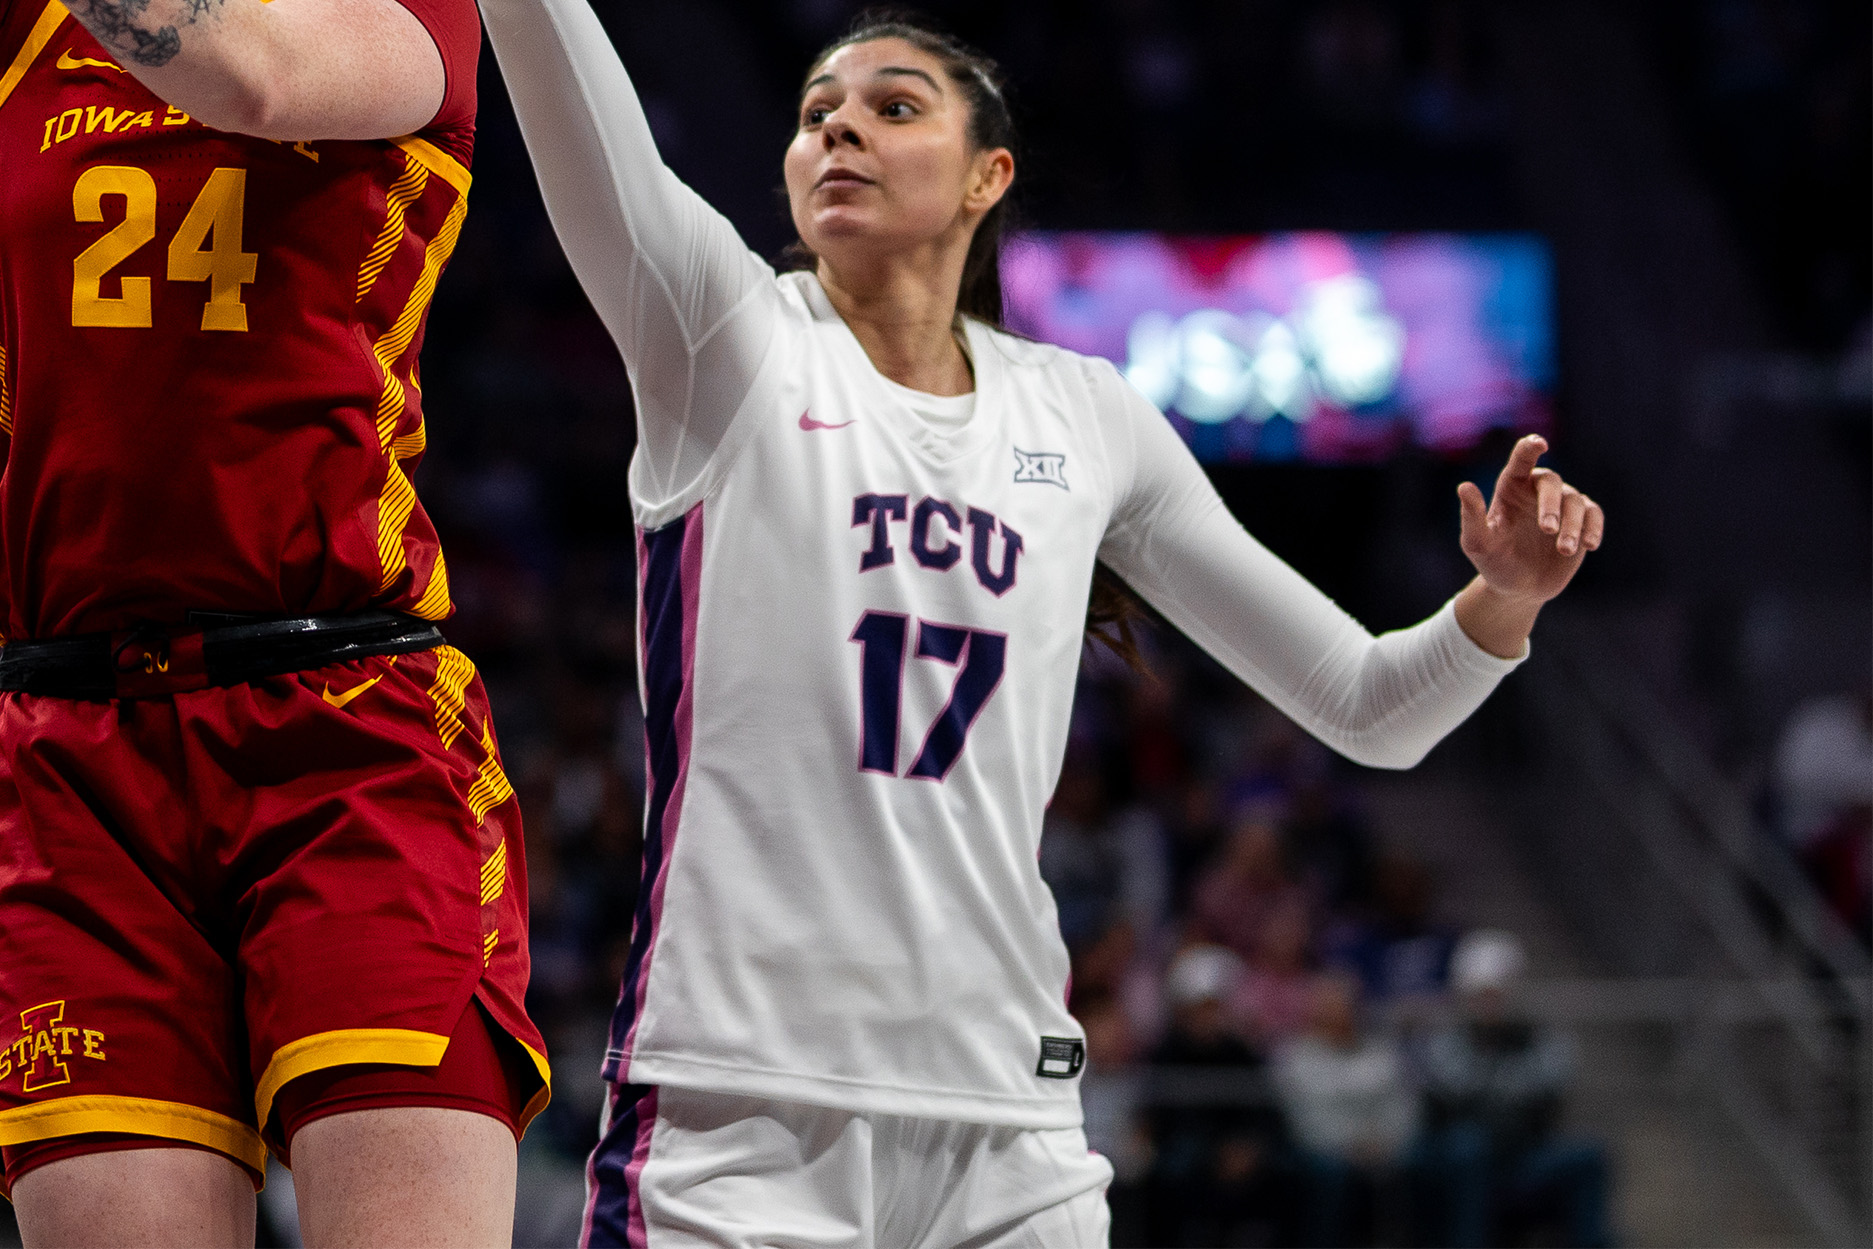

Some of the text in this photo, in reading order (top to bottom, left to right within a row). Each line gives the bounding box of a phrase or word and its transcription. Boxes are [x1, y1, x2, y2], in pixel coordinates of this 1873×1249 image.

[39, 104, 155, 154] IOWA
[71, 164, 259, 332] 24
[850, 492, 1025, 599] TCU
[847, 609, 1009, 785] 17
